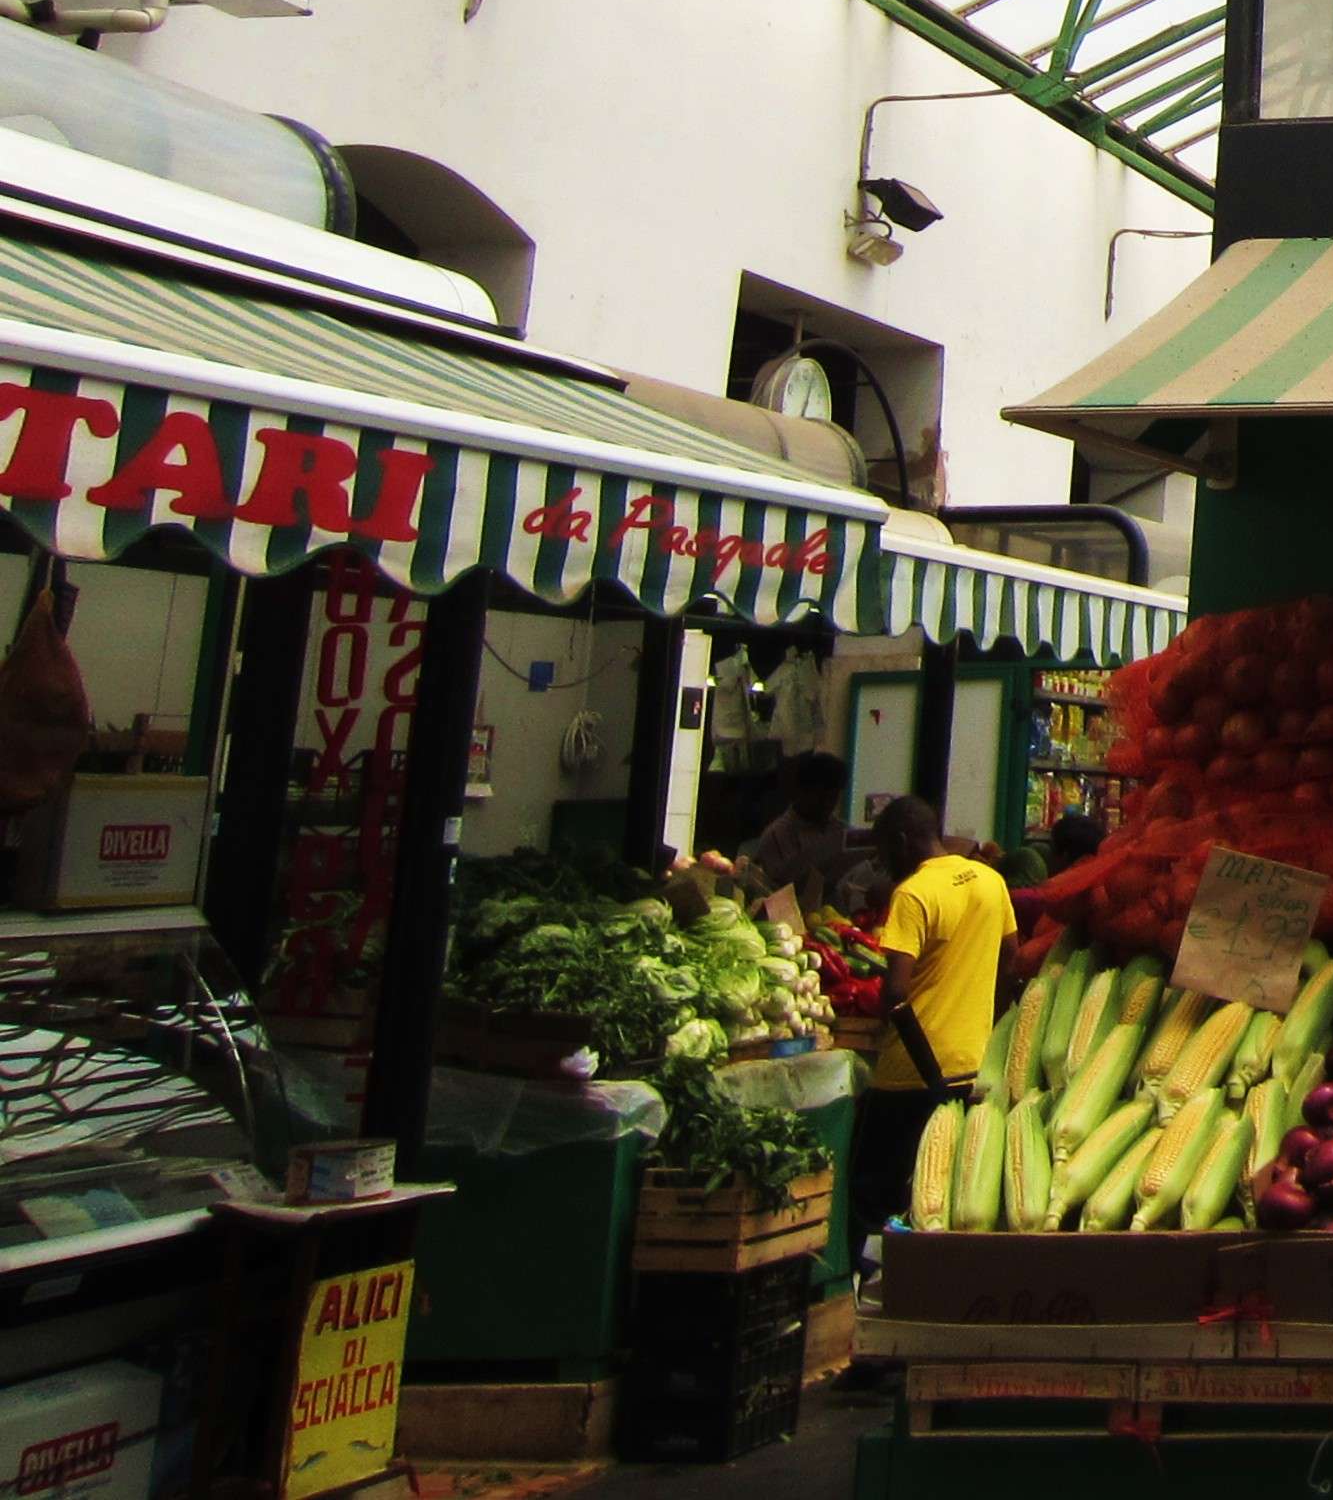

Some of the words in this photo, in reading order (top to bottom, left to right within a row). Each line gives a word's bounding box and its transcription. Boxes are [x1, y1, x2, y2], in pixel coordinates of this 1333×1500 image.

[0, 382, 436, 542] TARI
[522, 487, 592, 543] da
[608, 494, 835, 584] Pasquale
[102, 828, 167, 856] DIVELLA
[314, 1270, 403, 1336] ALICI
[343, 1336, 367, 1368] DI
[293, 1361, 394, 1431] SCIACCA
